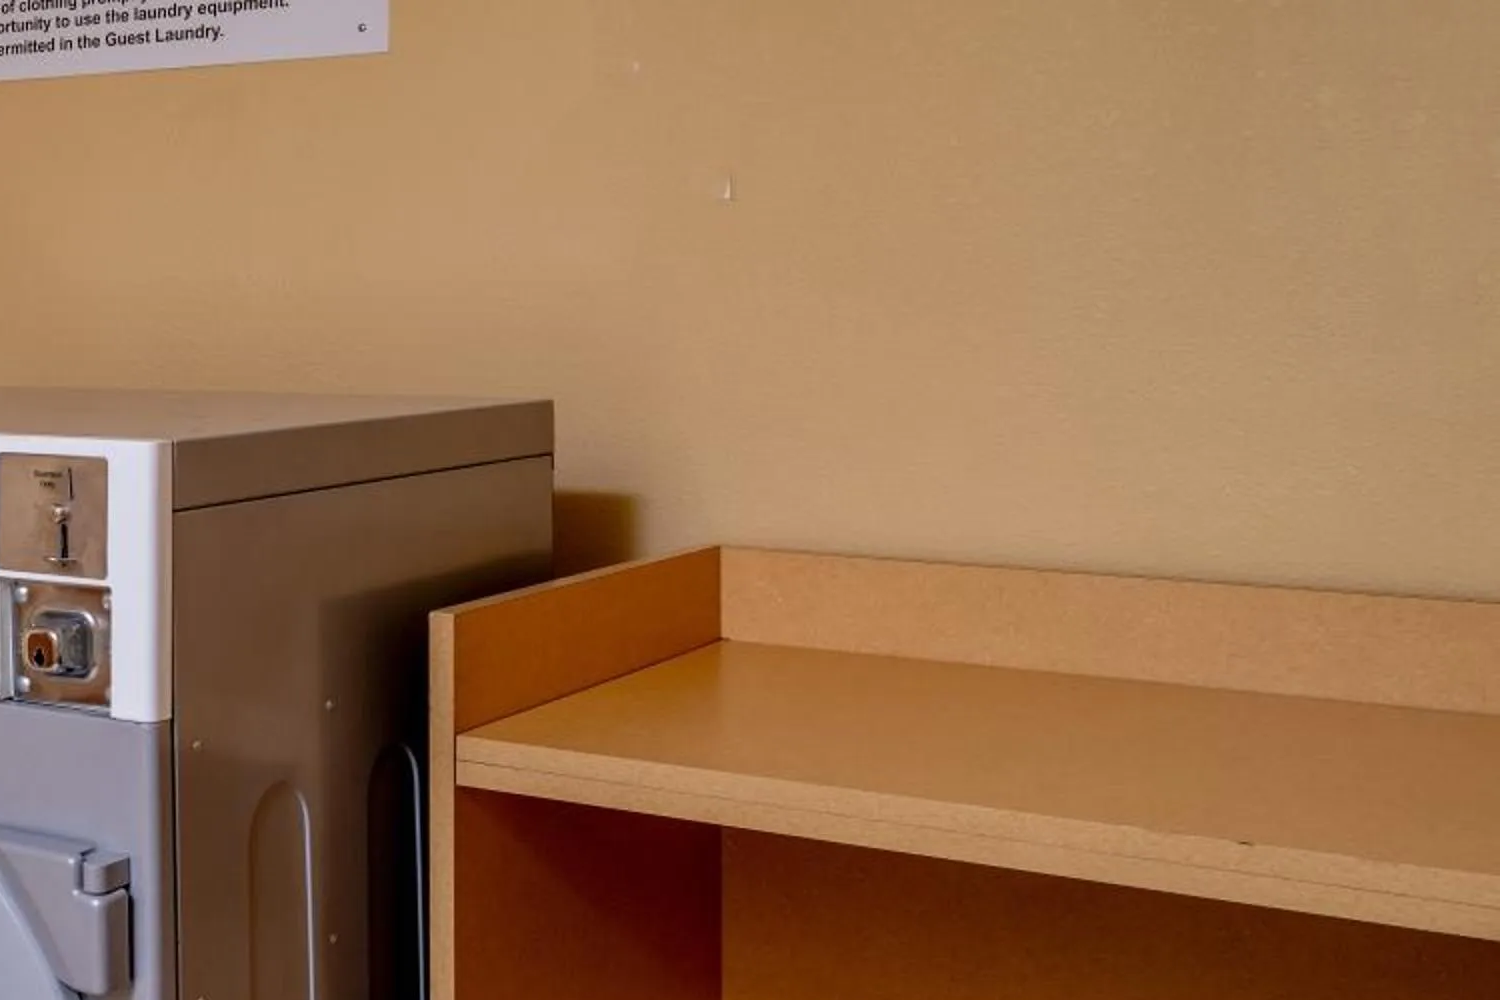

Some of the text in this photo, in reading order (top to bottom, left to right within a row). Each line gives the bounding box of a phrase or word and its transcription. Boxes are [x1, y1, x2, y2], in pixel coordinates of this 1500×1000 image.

[1, 0, 14, 14] of
[19, 0, 77, 12] clothing
[55, 16, 71, 29] to
[74, 13, 101, 27] use
[105, 8, 129, 24] the
[134, 3, 193, 21] laundry
[197, 0, 290, 17] equipment.
[59, 36, 73, 51] in
[76, 35, 101, 49] the
[105, 30, 150, 47] Guest
[154, 23, 225, 42] Laundry.
